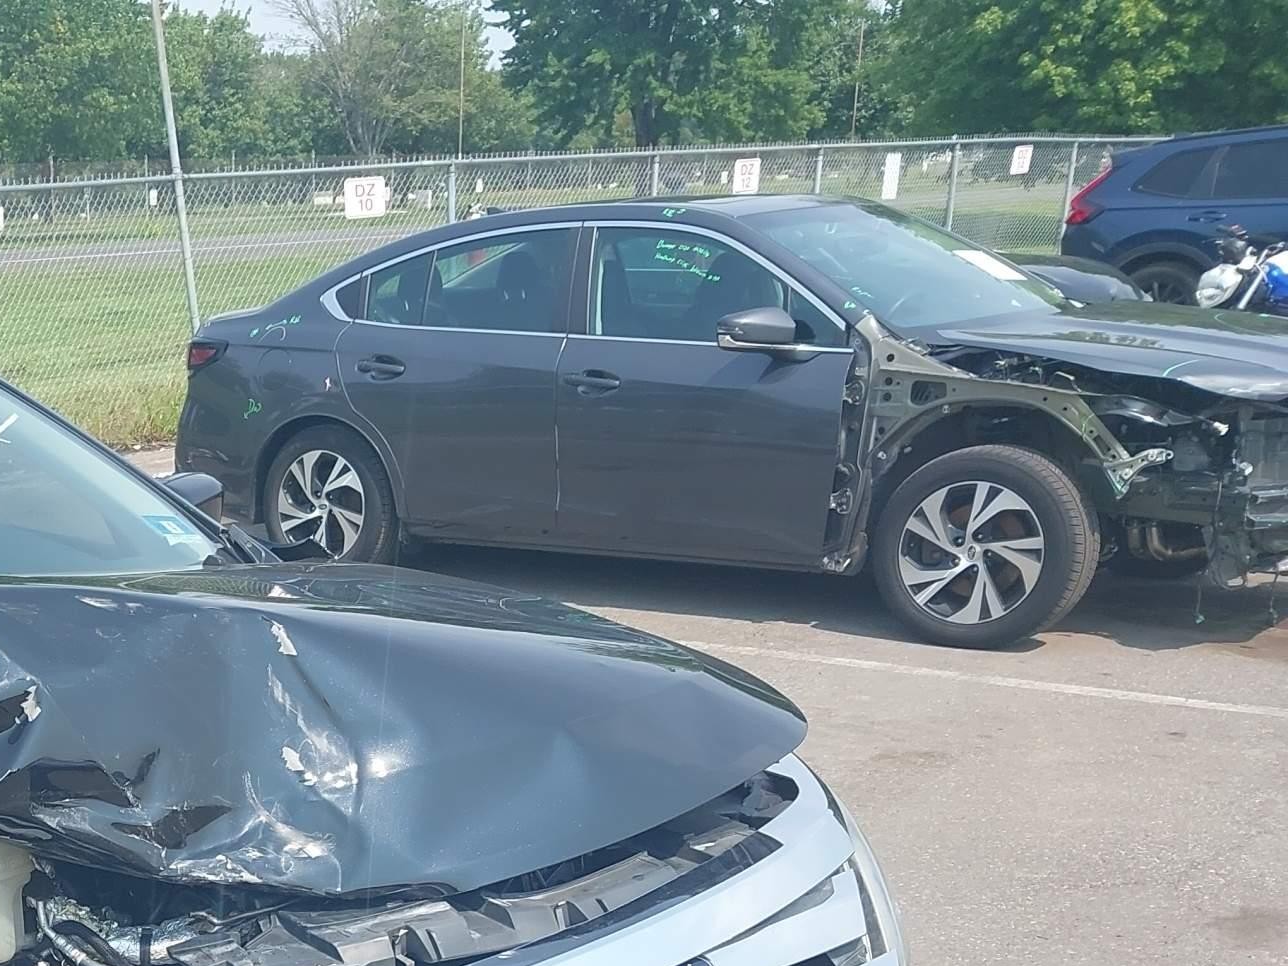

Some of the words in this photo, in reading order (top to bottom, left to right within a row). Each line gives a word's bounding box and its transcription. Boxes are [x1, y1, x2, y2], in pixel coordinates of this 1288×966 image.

[741, 163, 755, 177] DZ
[355, 183, 377, 198] DZ
[358, 198, 374, 211] 10
